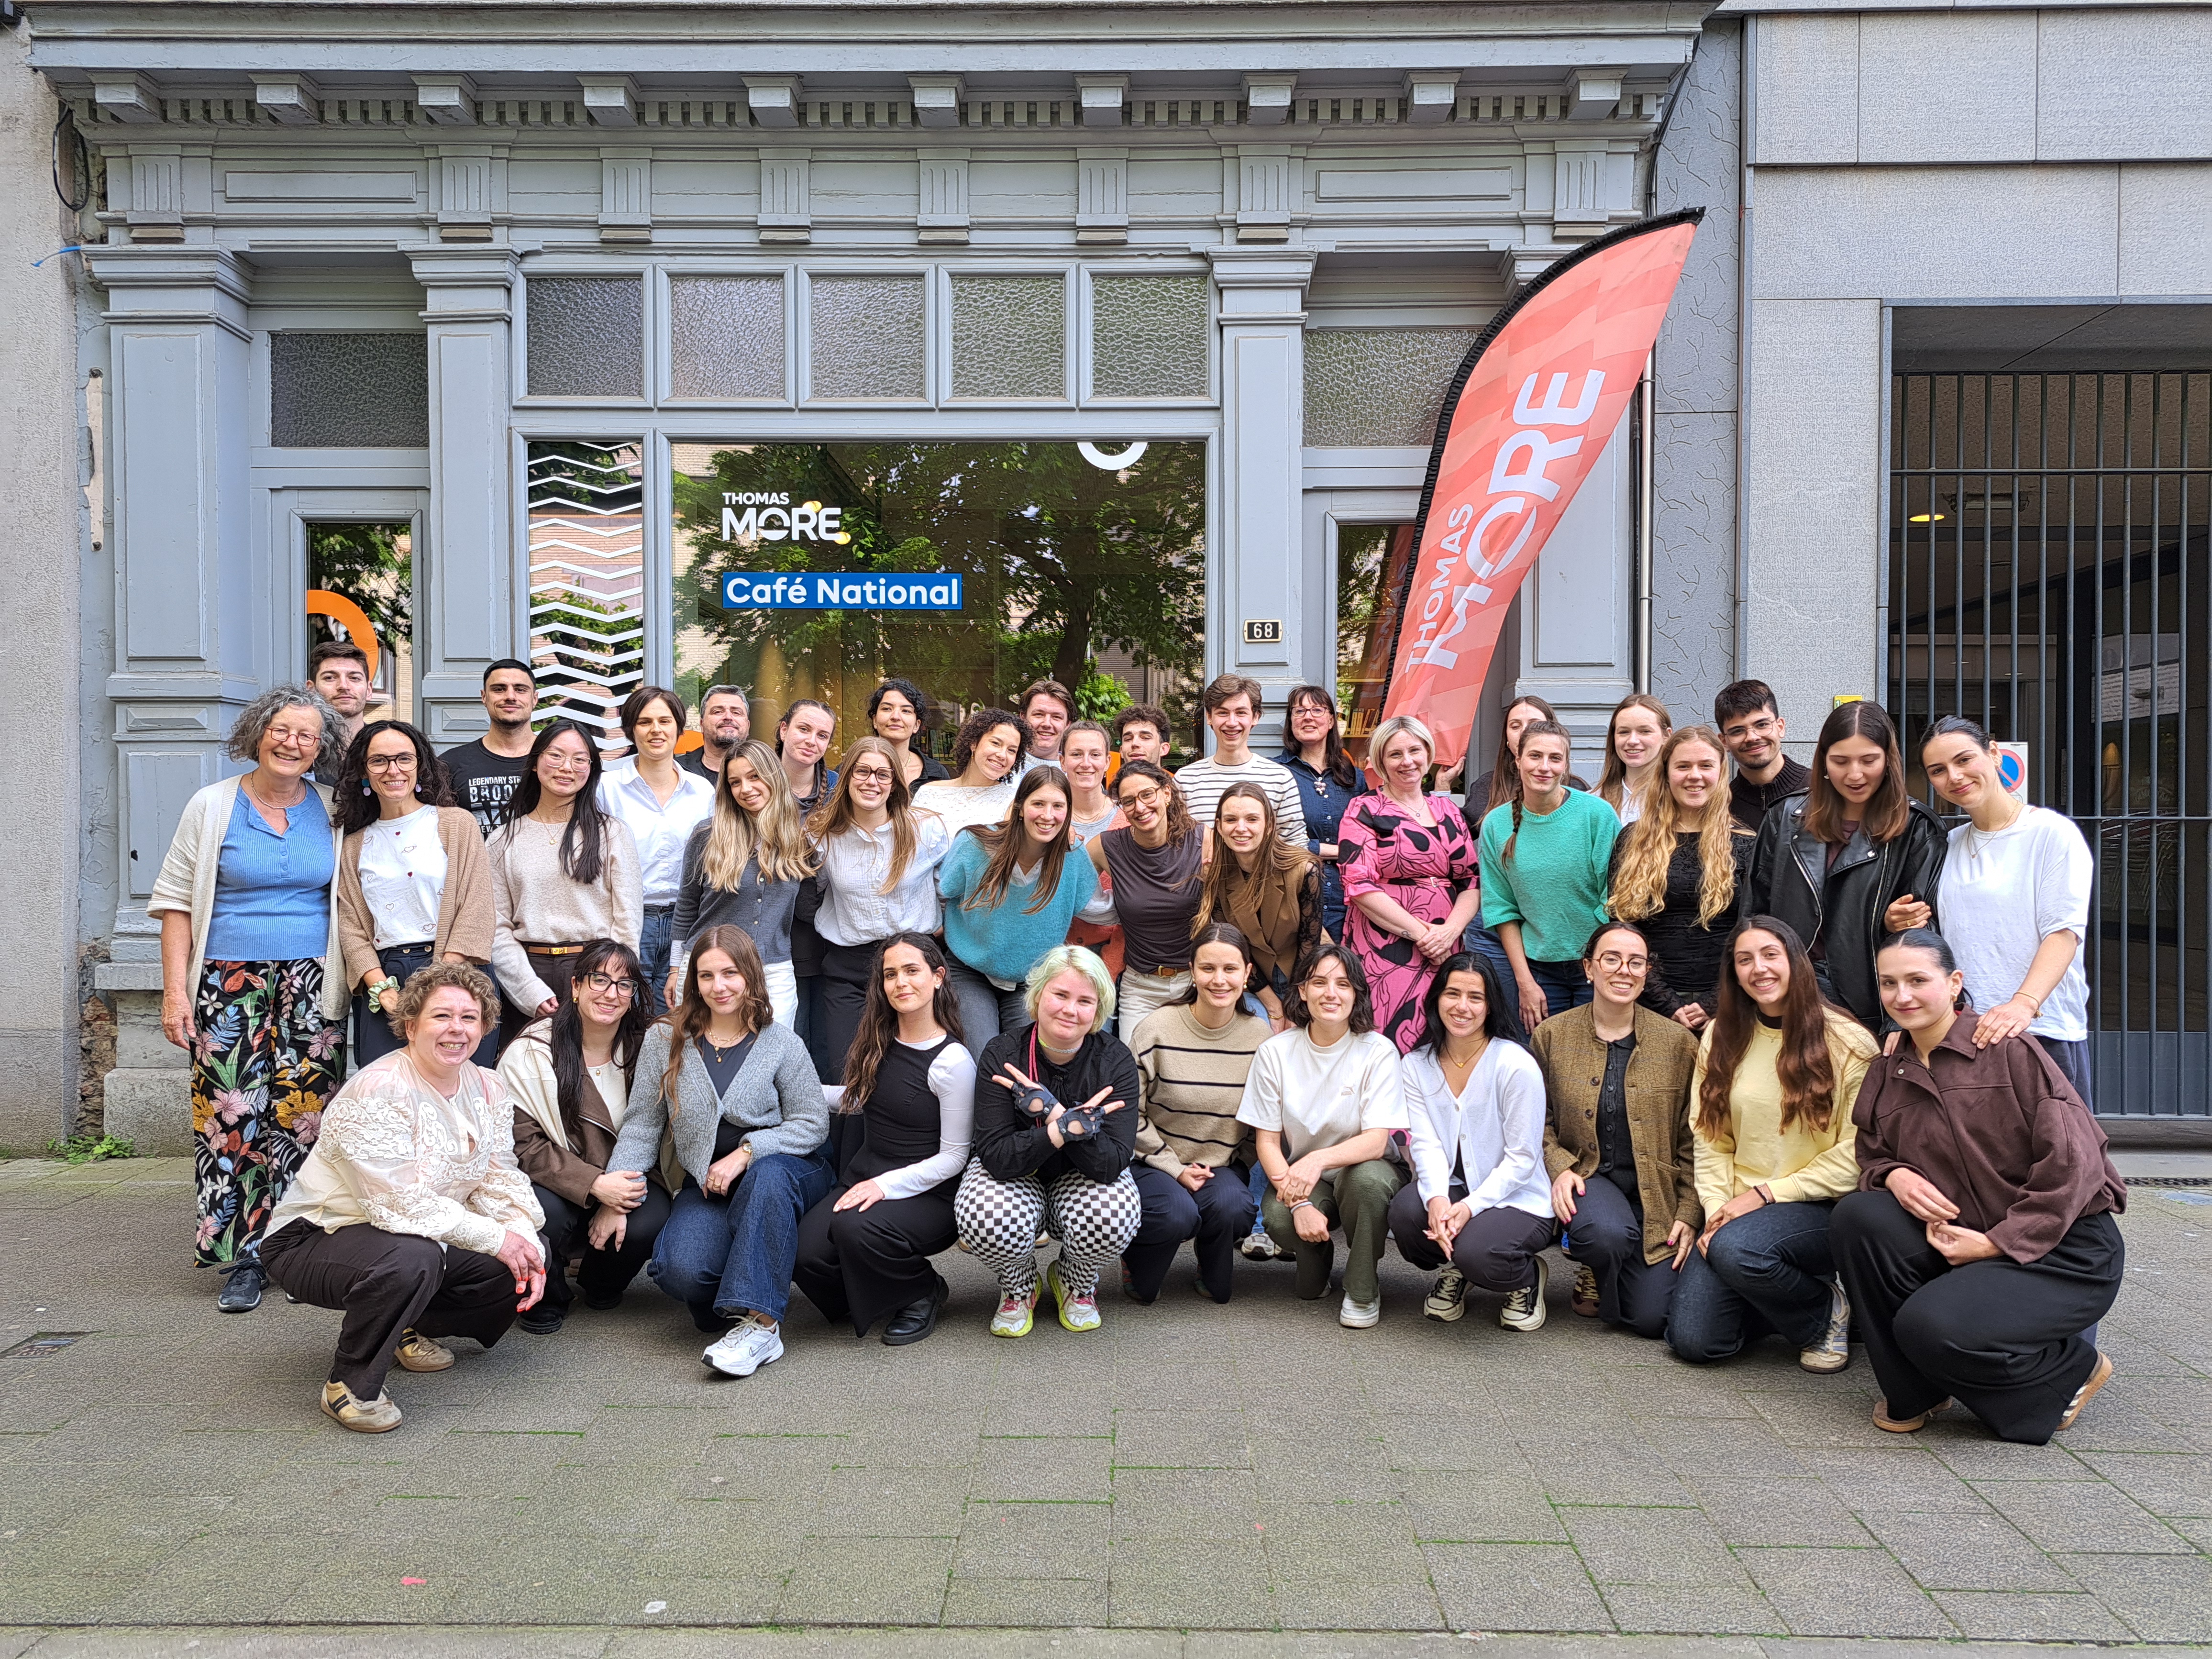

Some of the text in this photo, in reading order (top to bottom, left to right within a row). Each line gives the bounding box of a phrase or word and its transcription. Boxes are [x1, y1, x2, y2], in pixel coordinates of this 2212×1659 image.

[722, 492, 789, 505] THOMAS
[722, 507, 841, 541] MORE
[1421, 368, 1605, 670] MORE
[727, 577, 957, 605] Café National
[1405, 503, 1473, 673] THOMAS
[1254, 623, 1272, 638] 68
[469, 775, 522, 786] LEGENDARY STR
[469, 785, 519, 803] BROO
